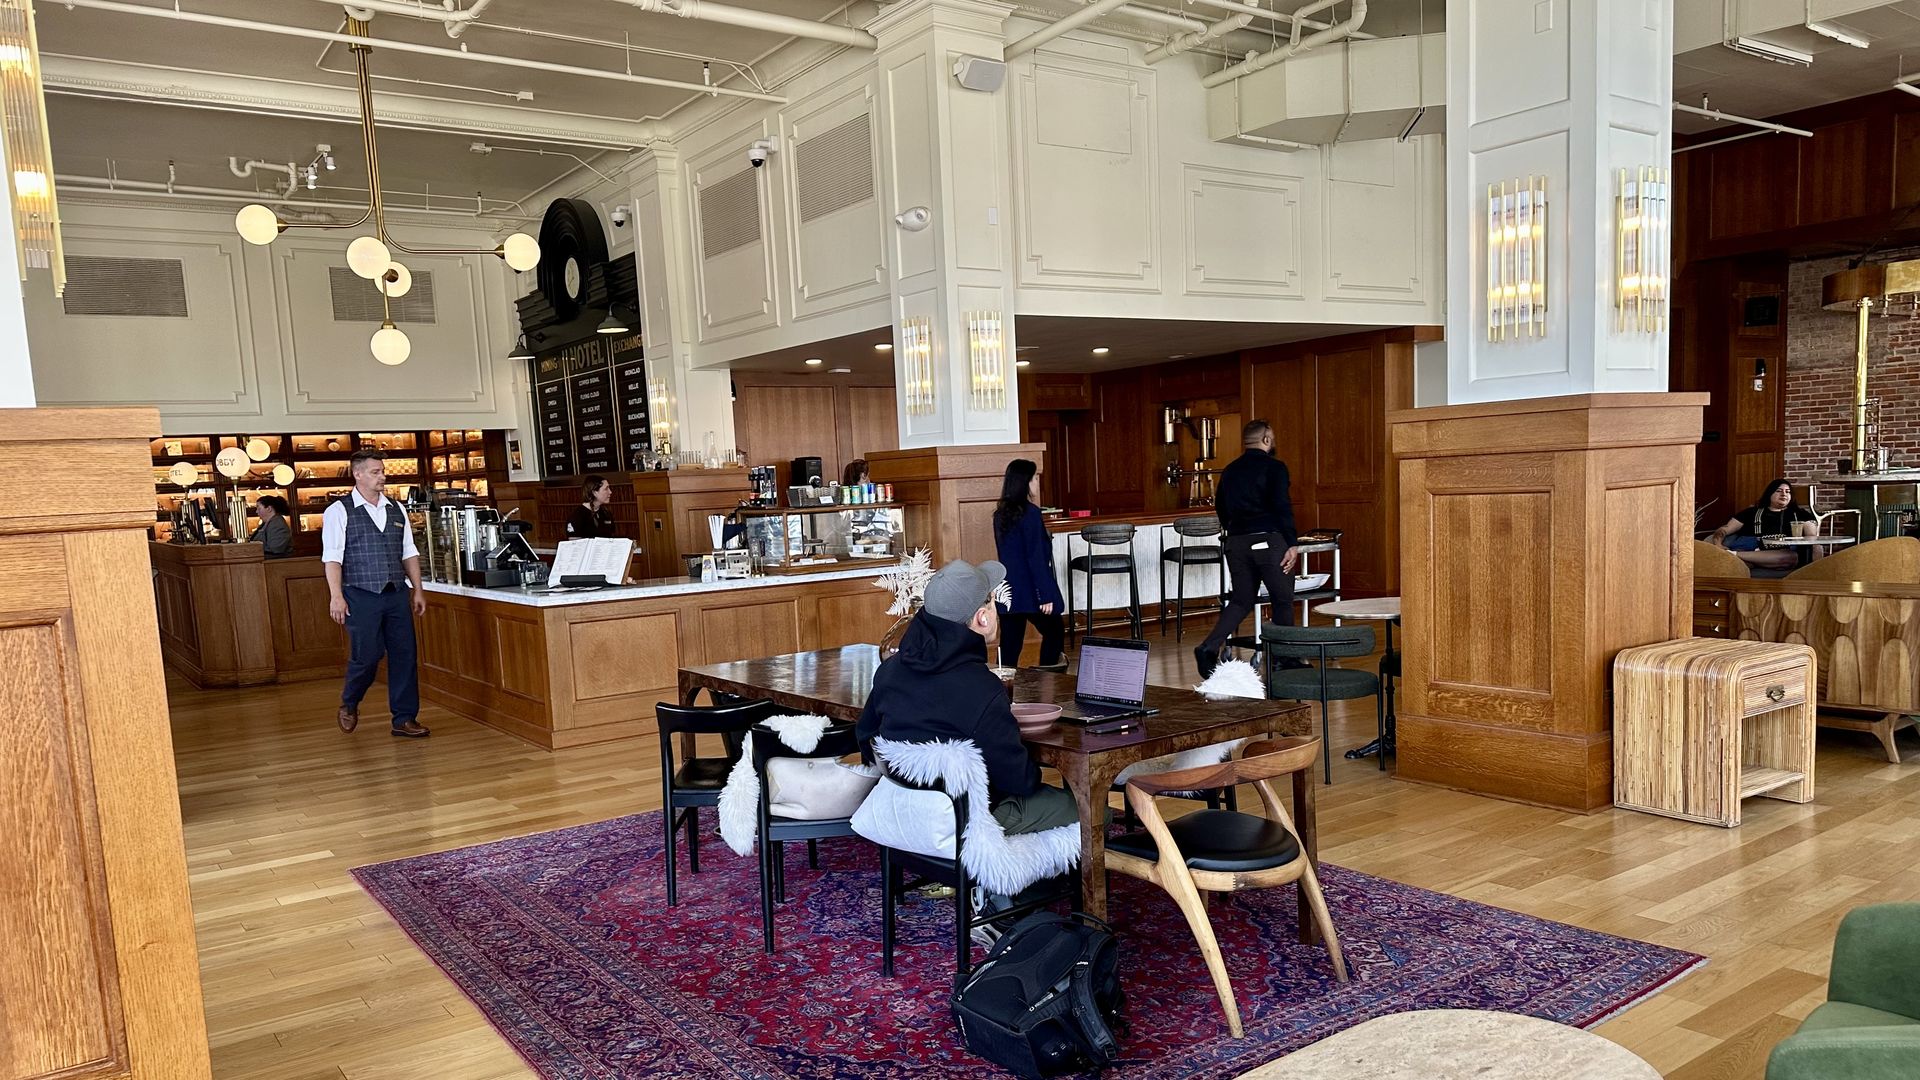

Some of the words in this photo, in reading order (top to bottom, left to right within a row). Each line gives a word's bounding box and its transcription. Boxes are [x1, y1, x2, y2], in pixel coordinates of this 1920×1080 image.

[570, 340, 604, 370] HOTEL
[614, 335, 642, 353] EXCHANG
[625, 367, 640, 376] IRONCLAD
[590, 390, 600, 398] CLOUD
[628, 412, 645, 420] BUCKHORN
[630, 427, 647, 435] KEYSTONE
